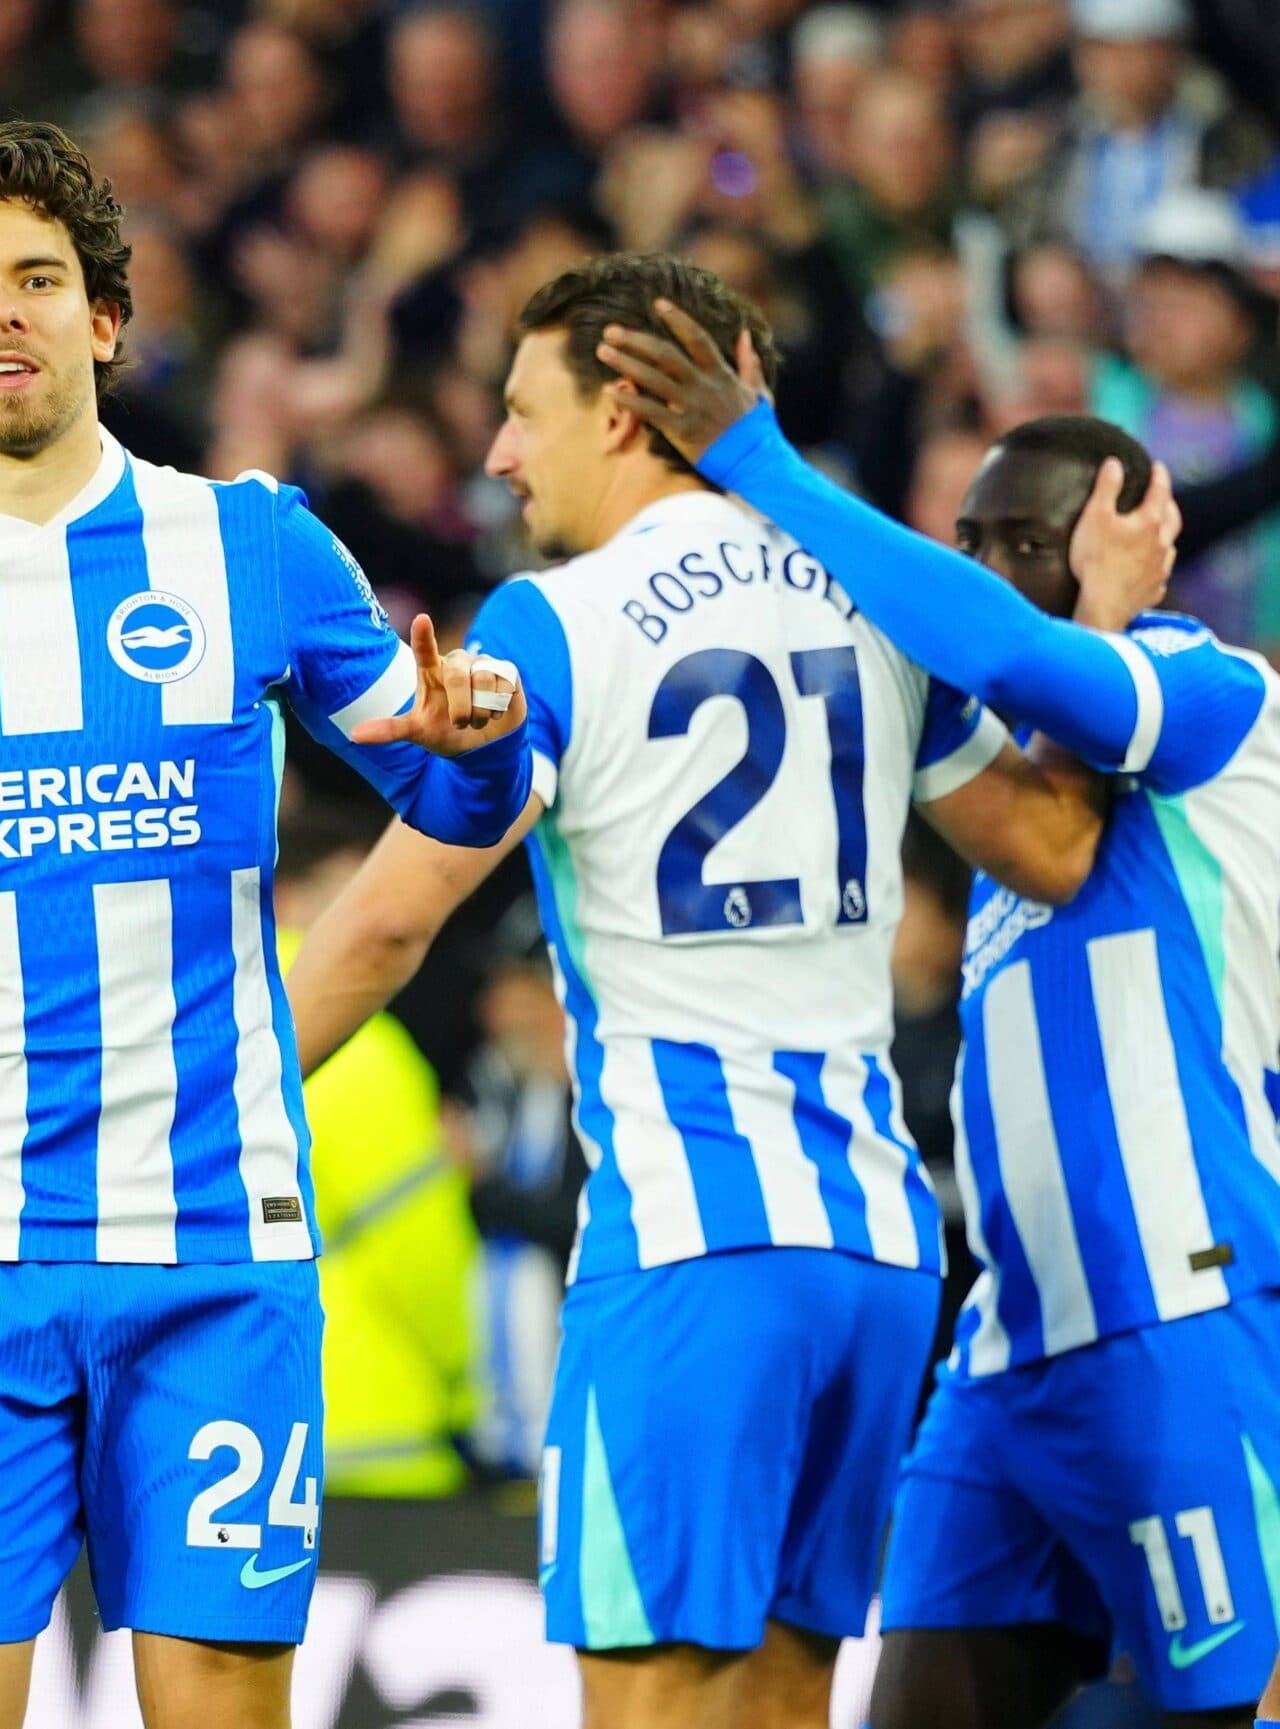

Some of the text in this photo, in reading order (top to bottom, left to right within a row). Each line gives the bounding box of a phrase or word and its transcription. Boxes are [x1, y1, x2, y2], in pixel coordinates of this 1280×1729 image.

[647, 645, 869, 938] 21
[186, 1420, 319, 1549] 24
[1128, 1505, 1236, 1633] 11
